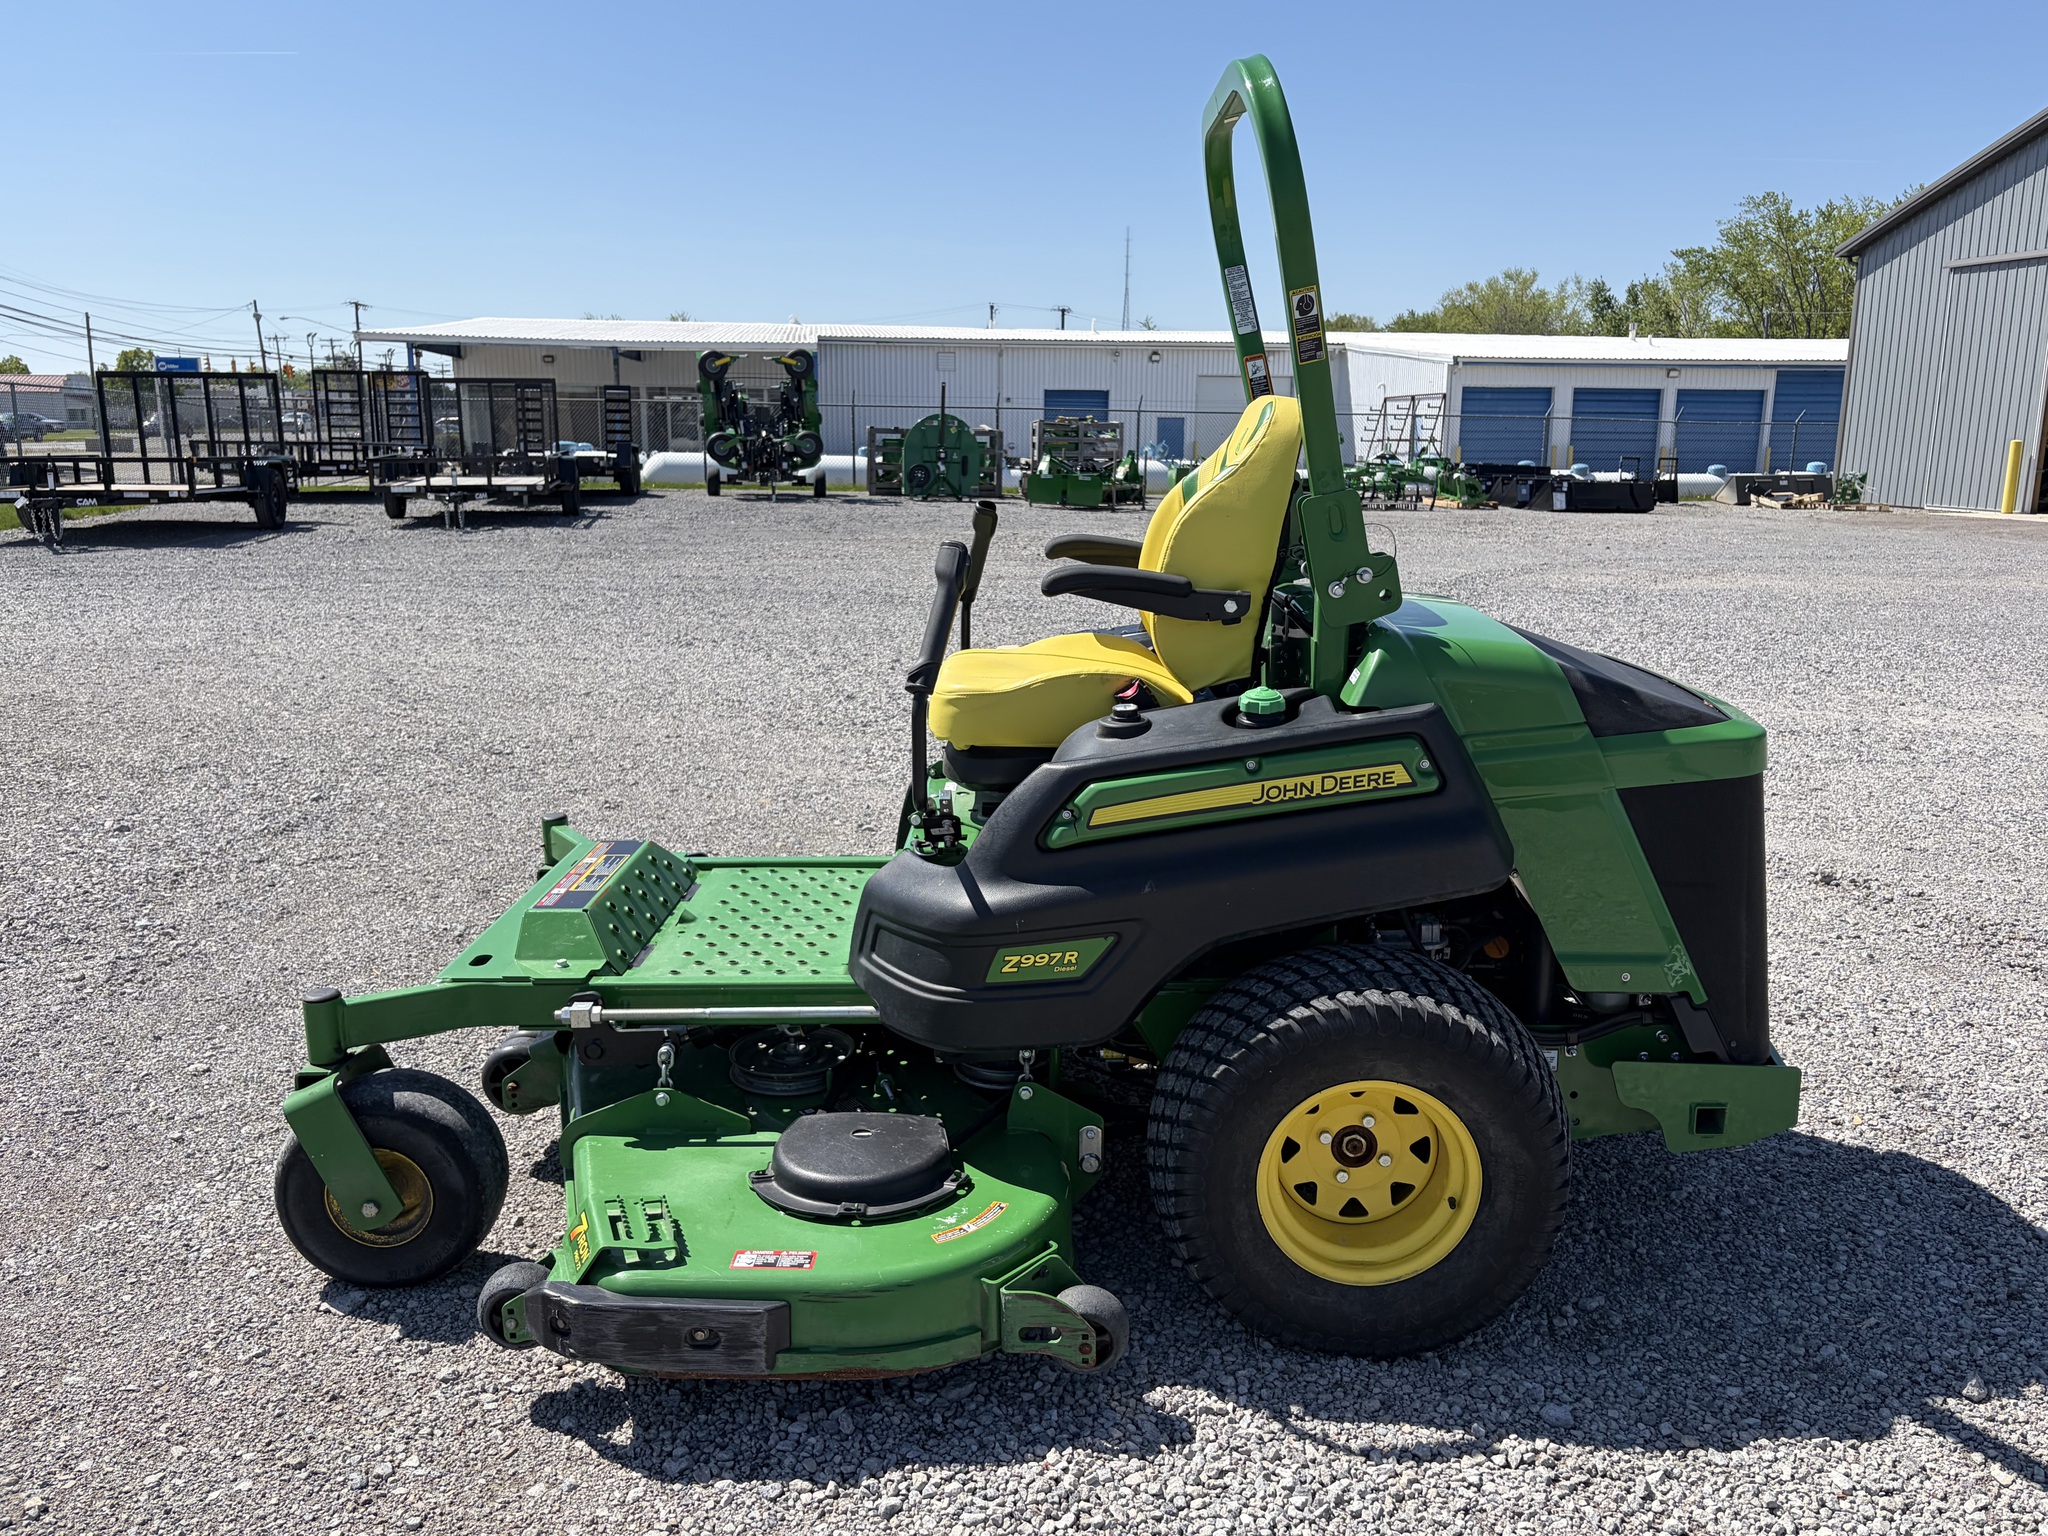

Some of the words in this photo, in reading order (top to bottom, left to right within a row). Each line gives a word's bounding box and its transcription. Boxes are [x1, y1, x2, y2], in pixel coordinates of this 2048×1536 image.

[76, 497, 98, 506] CAM
[1252, 780, 1315, 803] JOHN
[1320, 771, 1396, 794] DEERE
[1001, 951, 1079, 973] Z997R
[1053, 965, 1078, 973] Diesel
